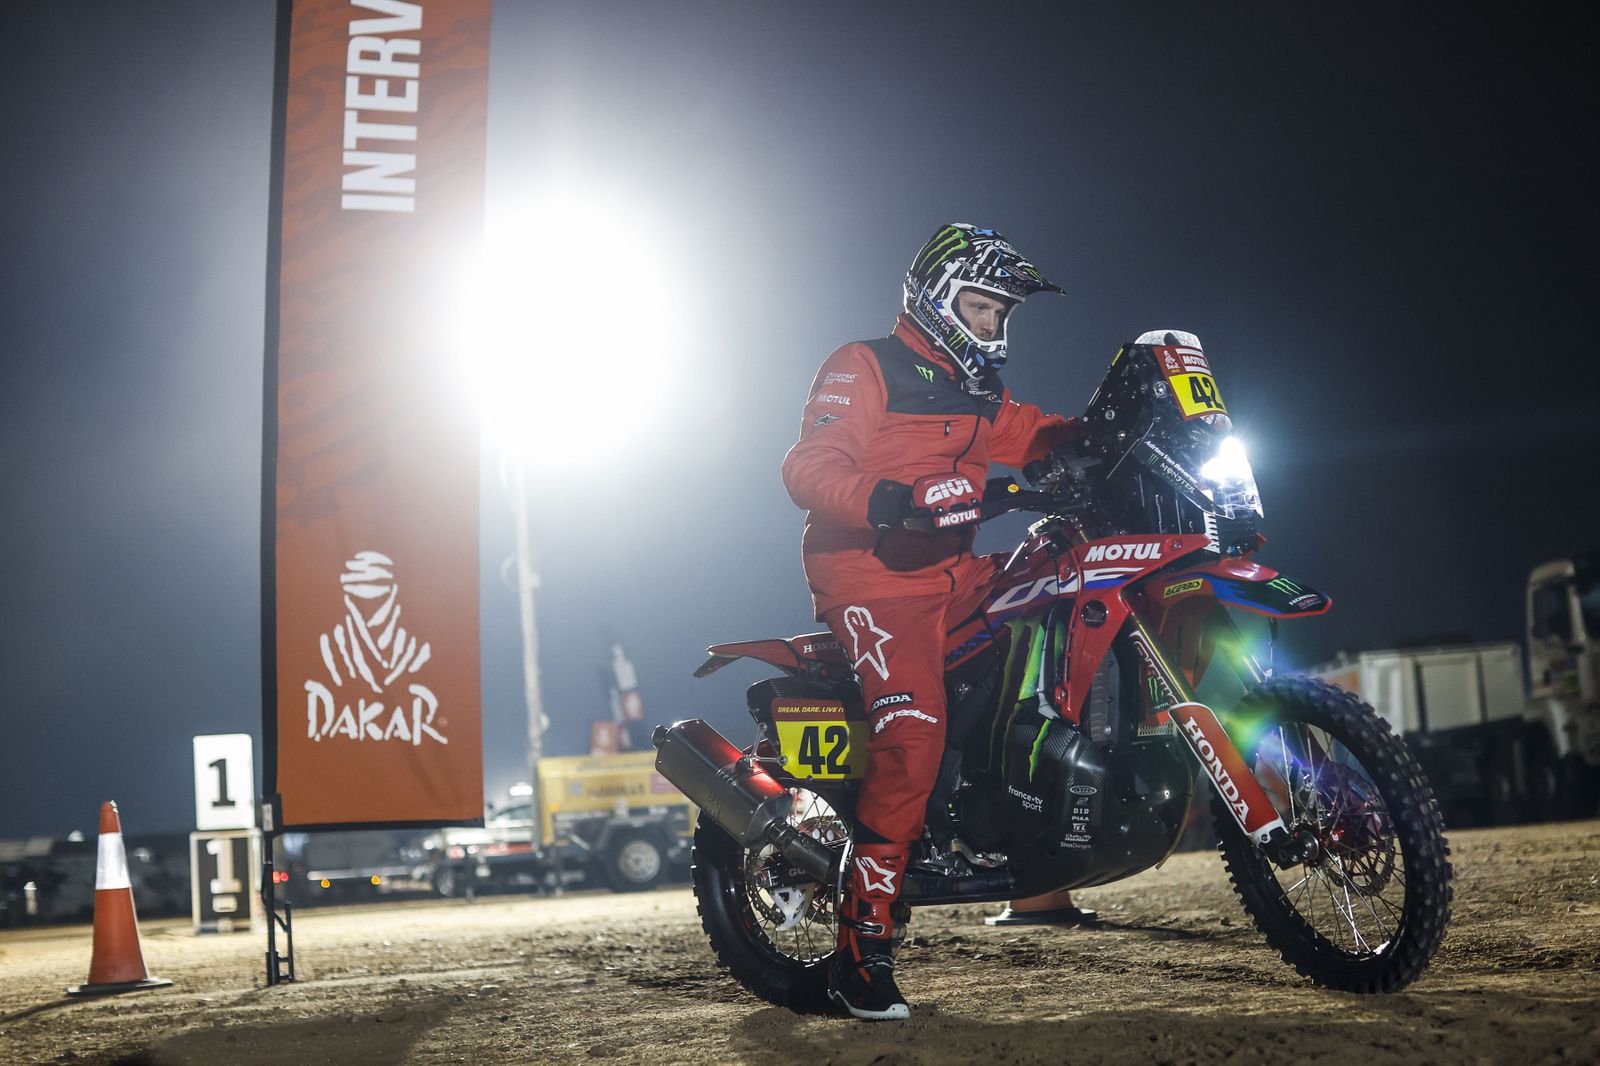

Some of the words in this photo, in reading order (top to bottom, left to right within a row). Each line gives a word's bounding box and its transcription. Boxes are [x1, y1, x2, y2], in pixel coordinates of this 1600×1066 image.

[341, 0, 423, 212] INTERV
[818, 394, 850, 405] MOTUL
[1189, 376, 1224, 409] 42
[939, 509, 978, 527] MOTUL
[1084, 543, 1162, 562] MOTUL
[304, 679, 448, 746] DAKAR
[872, 694, 912, 710] ONDA
[799, 725, 851, 775] 42
[208, 758, 236, 807] 1
[1183, 717, 1250, 825] HONDA
[1022, 800, 1042, 813] sport
